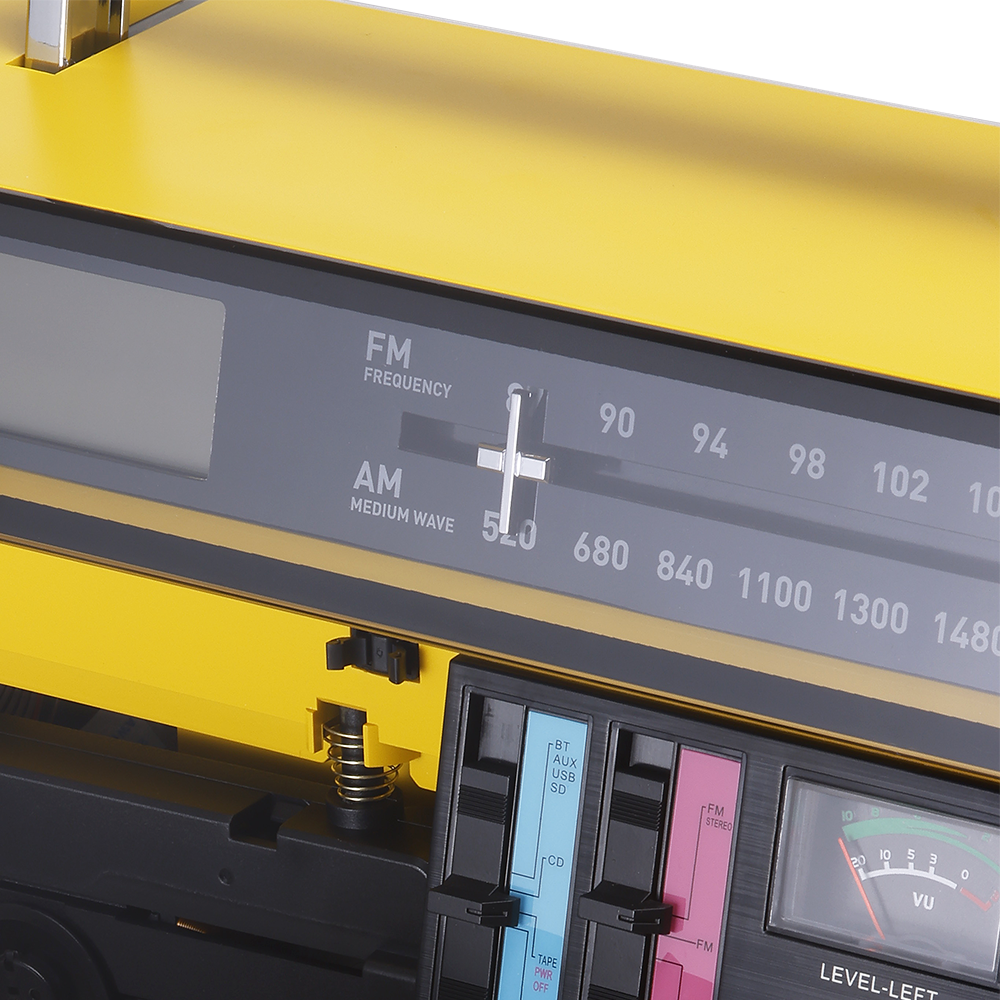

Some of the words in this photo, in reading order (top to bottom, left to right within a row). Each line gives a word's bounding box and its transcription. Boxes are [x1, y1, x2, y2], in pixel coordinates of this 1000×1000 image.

[366, 330, 412, 369] FM
[364, 366, 452, 399] FREQUENCY
[600, 402, 635, 438] 90
[692, 422, 728, 459] 94
[789, 443, 826, 480] 98
[873, 461, 930, 503] 102
[353, 460, 403, 498] AM
[350, 496, 410, 523] MEDIUM
[413, 510, 455, 533] WAVE
[574, 532, 629, 571] 680
[657, 550, 713, 590] 840
[738, 567, 812, 612] 1100
[835, 589, 909, 634] 1300
[555, 739, 570, 752] BT
[553, 755, 577, 769] AUX
[552, 768, 576, 783] USB
[550, 782, 567, 795] SD
[707, 803, 725, 817] FM
[705, 816, 733, 832] STEREO
[548, 855, 565, 868] CD
[851, 855, 866, 868] 20
[879, 849, 892, 861] 10
[907, 849, 915, 860] 5
[930, 853, 938, 865] 3
[912, 891, 935, 911] VU
[696, 938, 714, 953] FM
[538, 953, 557, 969] TAPE
[534, 966, 553, 981] PWR
[532, 980, 549, 993] OFF
